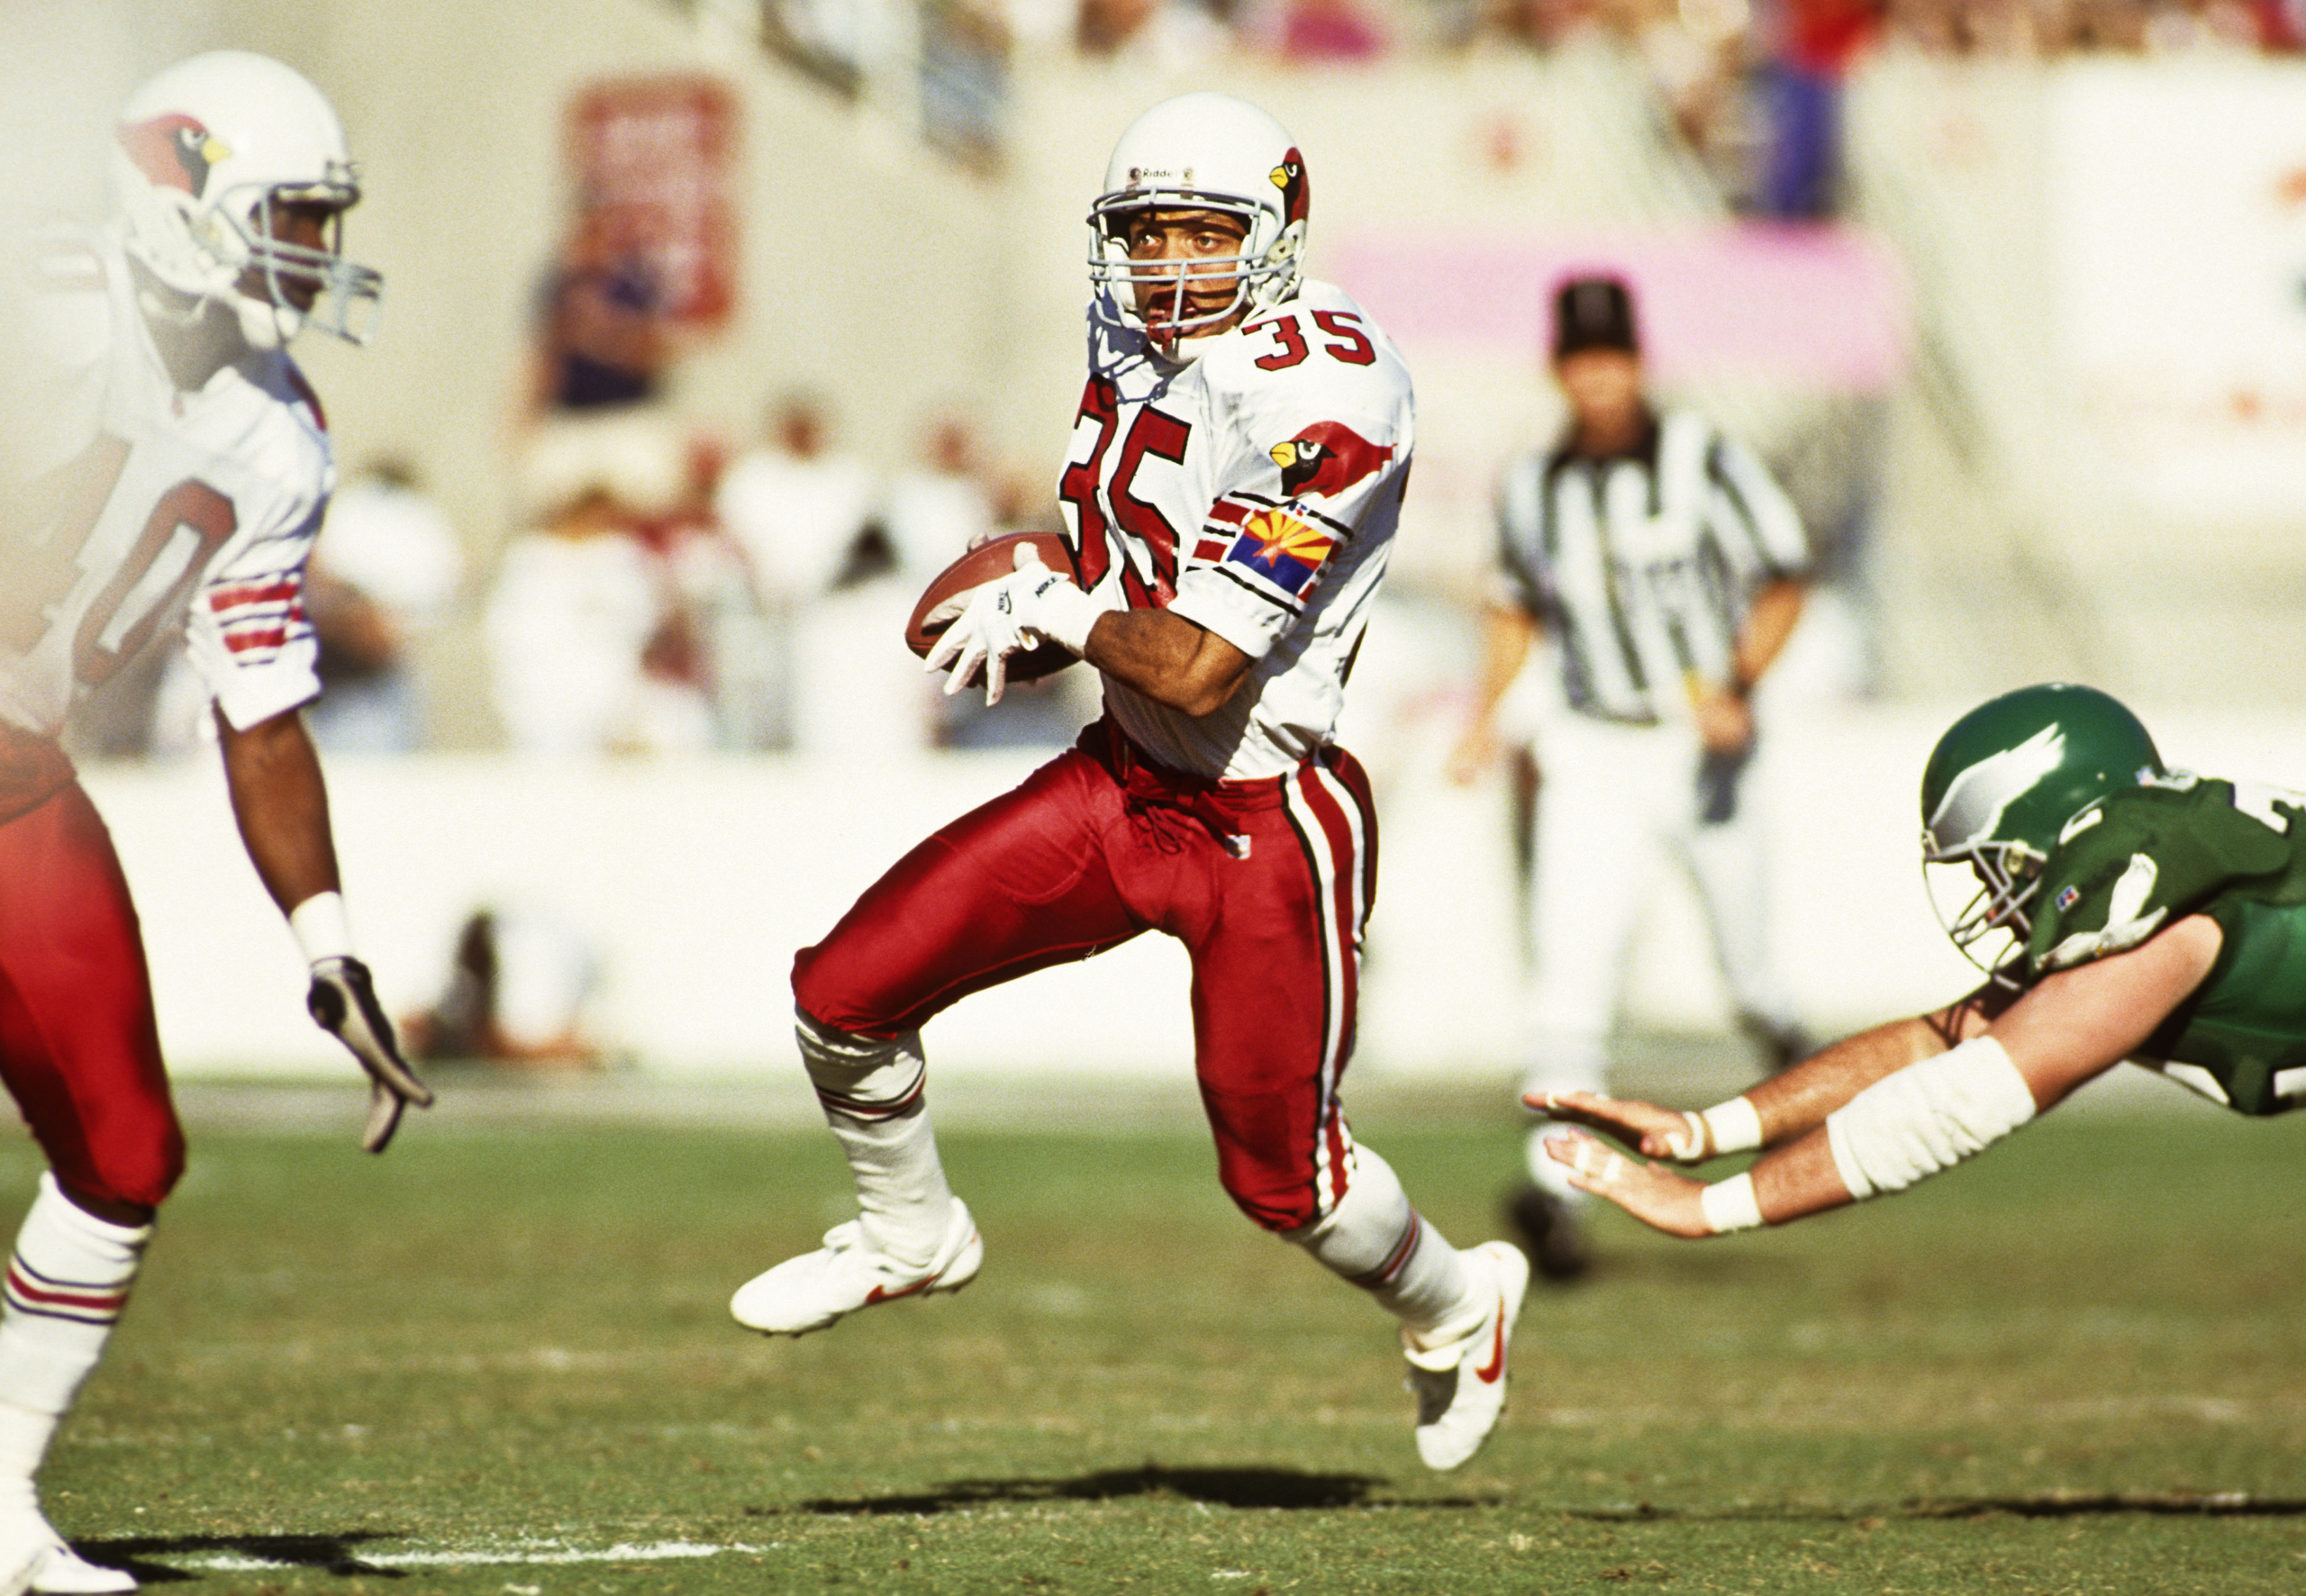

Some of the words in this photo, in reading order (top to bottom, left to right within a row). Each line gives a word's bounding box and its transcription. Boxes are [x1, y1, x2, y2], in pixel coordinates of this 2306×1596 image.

[1241, 309, 1376, 372] 35
[1060, 371, 1193, 611] 35
[1035, 576, 1058, 598] NIKE
